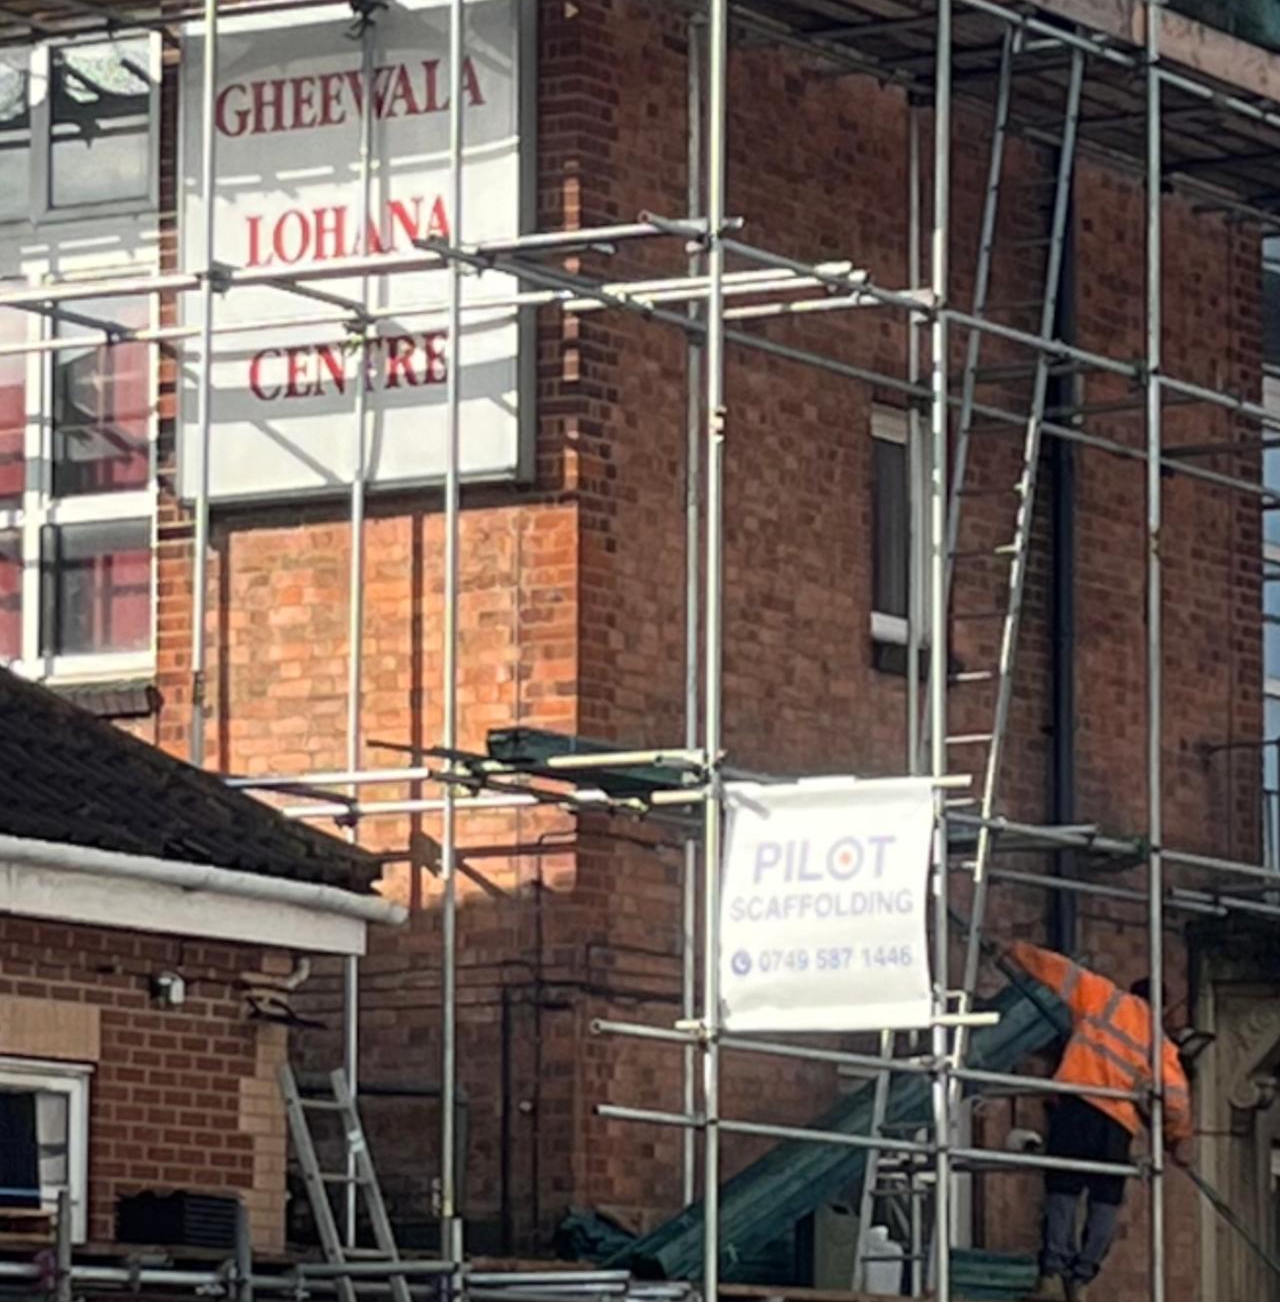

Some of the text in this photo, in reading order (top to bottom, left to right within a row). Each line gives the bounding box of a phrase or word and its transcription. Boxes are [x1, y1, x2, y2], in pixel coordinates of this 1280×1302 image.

[214, 56, 486, 138] GHEEWALA
[246, 195, 451, 267] LOHANA
[248, 332, 450, 401] CENTRE
[753, 836, 897, 884] PILOT
[729, 888, 913, 922] SCAFFOLDING
[759, 945, 913, 972] 0749 587 1446
